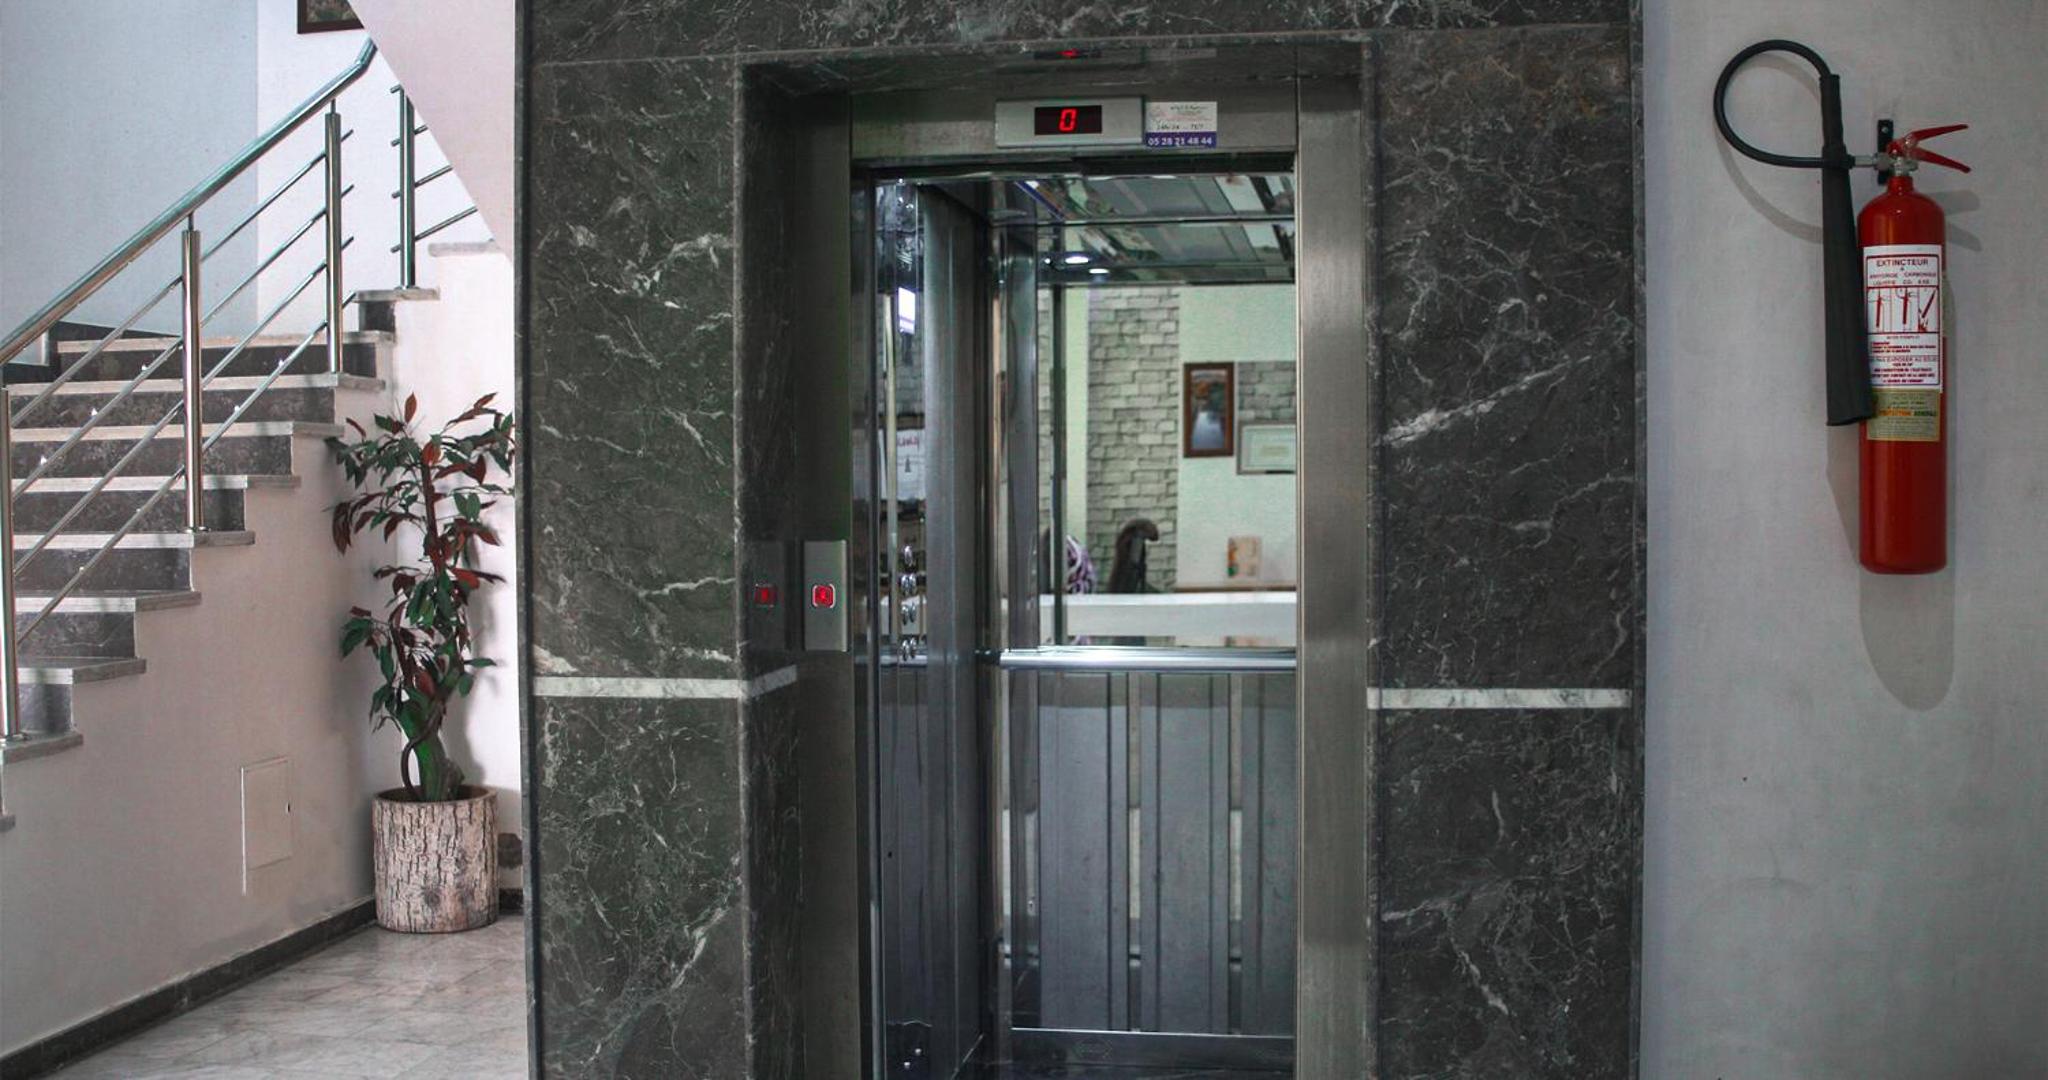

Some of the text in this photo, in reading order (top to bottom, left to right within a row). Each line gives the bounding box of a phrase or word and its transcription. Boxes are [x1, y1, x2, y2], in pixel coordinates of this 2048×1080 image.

[1059, 108, 1077, 131] 0
[1148, 137, 1160, 146] 05
[1201, 137, 1212, 145] 44
[1876, 258, 1929, 267] EXTINCTEUR
